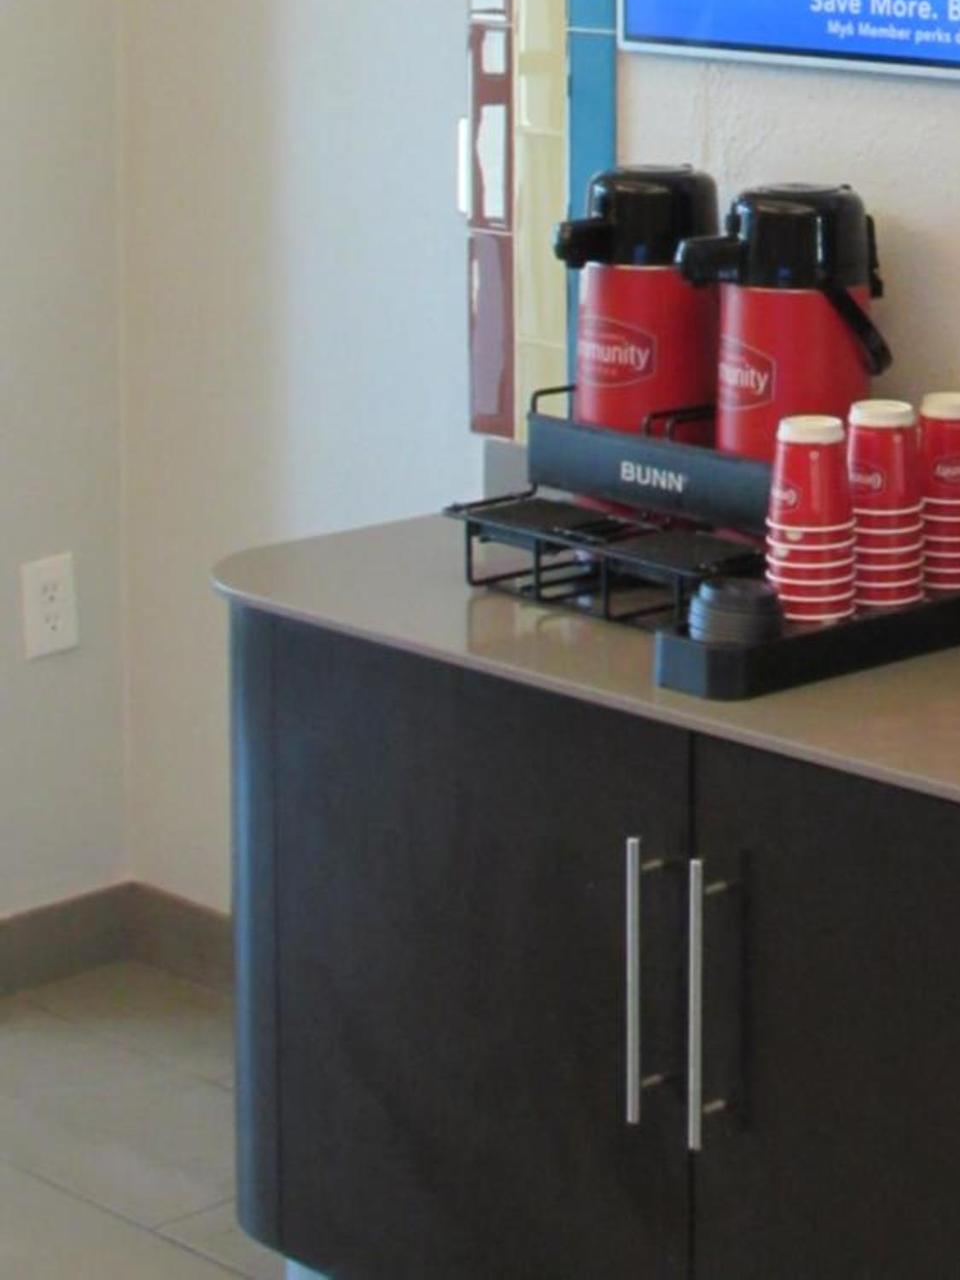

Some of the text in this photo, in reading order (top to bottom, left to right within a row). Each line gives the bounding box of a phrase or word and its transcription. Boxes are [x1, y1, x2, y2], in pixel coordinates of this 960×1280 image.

[858, 22, 911, 41] Member
[915, 26, 951, 44] perks
[620, 461, 684, 493] BUNN
